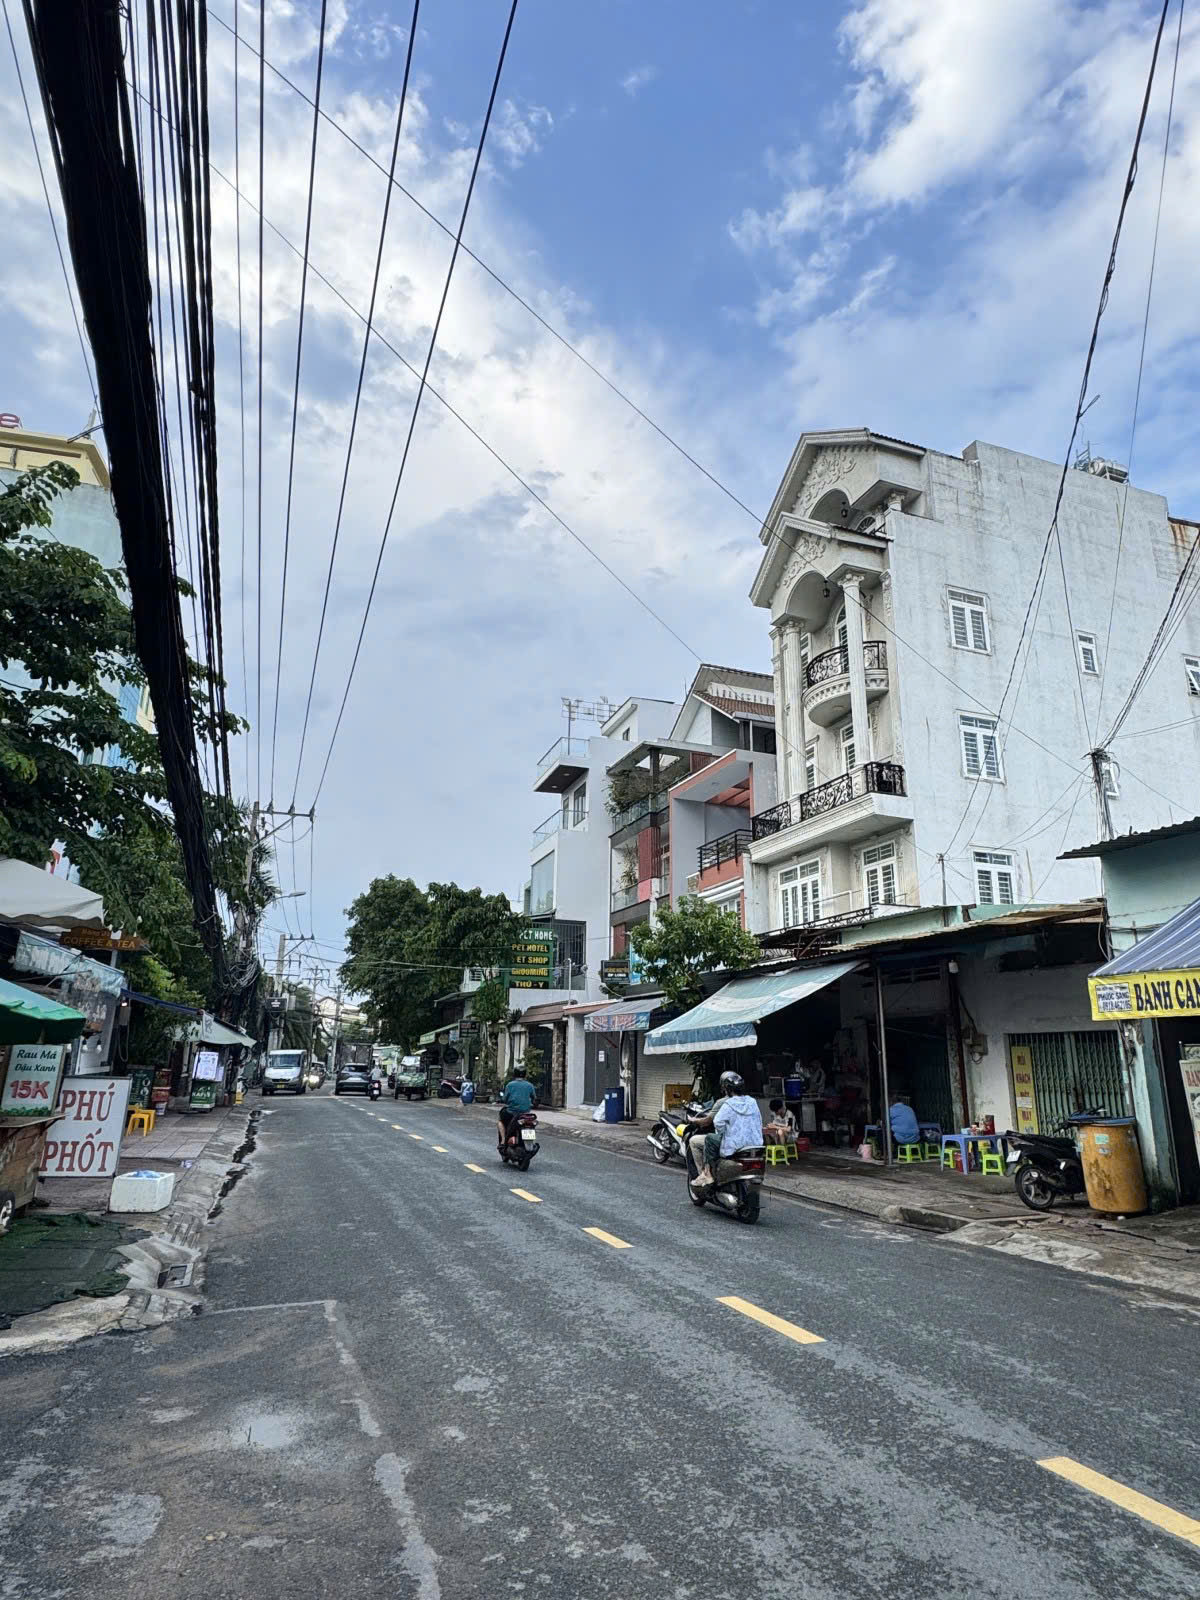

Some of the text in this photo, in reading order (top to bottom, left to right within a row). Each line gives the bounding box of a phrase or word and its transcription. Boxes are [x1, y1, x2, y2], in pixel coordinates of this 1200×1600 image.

[534, 930, 553, 941] HOME
[63, 936, 104, 947] COFFEE
[117, 940, 136, 949] TEA
[527, 944, 549, 952] HOTEL
[527, 956, 549, 964] SHOP
[1134, 974, 1174, 1011] BÁNH
[16, 1049, 57, 1060] Rau Má
[34, 1063, 56, 1072] Xanh
[9, 1080, 50, 1099] 15K
[60, 1082, 115, 1121] PHÚ
[40, 1127, 114, 1172] PHỐT
